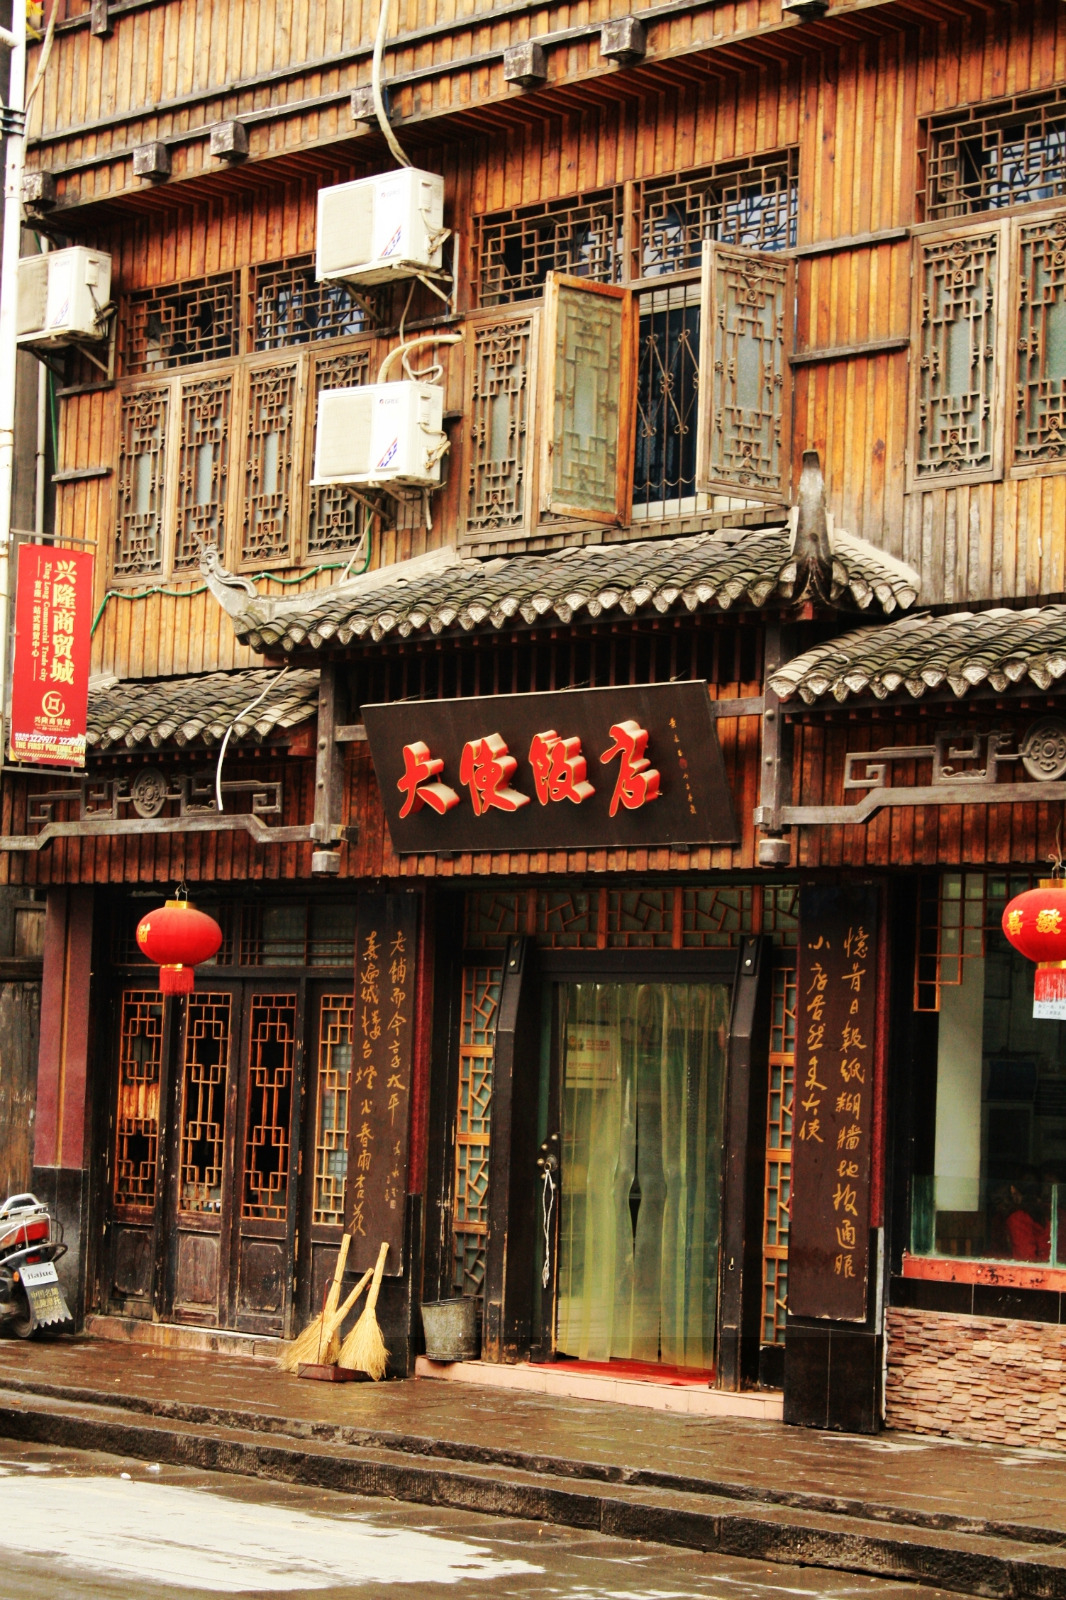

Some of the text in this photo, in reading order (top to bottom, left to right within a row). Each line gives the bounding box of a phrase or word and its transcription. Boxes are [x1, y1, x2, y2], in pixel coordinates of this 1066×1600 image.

[38, 562, 52, 682] Xing Long Commercial Trade city
[49, 560, 77, 685] 兴隆商贸城
[15, 741, 27, 749] THE
[28, 742, 45, 751] FIRST
